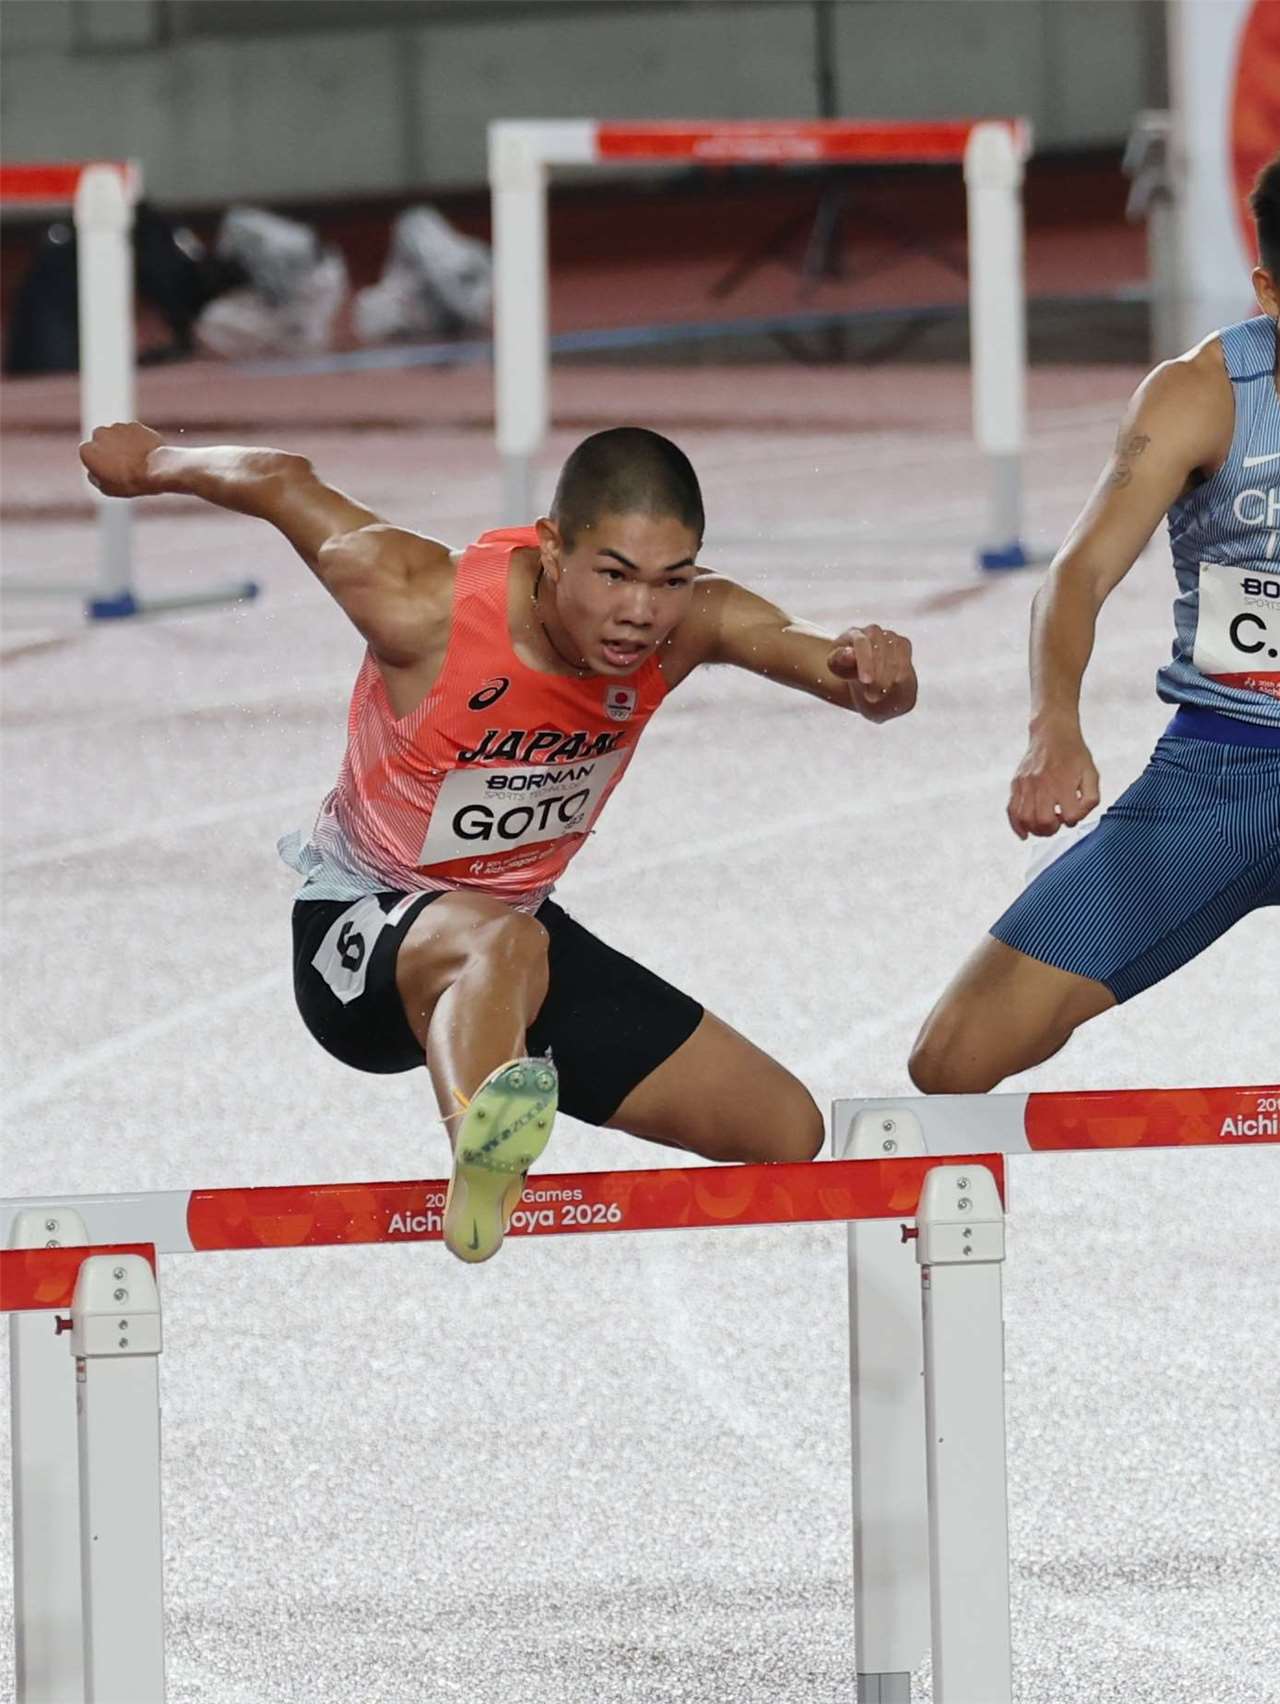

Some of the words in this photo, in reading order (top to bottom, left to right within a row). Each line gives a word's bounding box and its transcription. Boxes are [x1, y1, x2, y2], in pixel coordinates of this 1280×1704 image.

[486, 764, 596, 791] BORNAN
[452, 788, 591, 841] GOTO
[336, 920, 366, 973] 6
[425, 1193, 446, 1208] 20
[521, 1187, 583, 1203] Games
[561, 1203, 622, 1226] 2026
